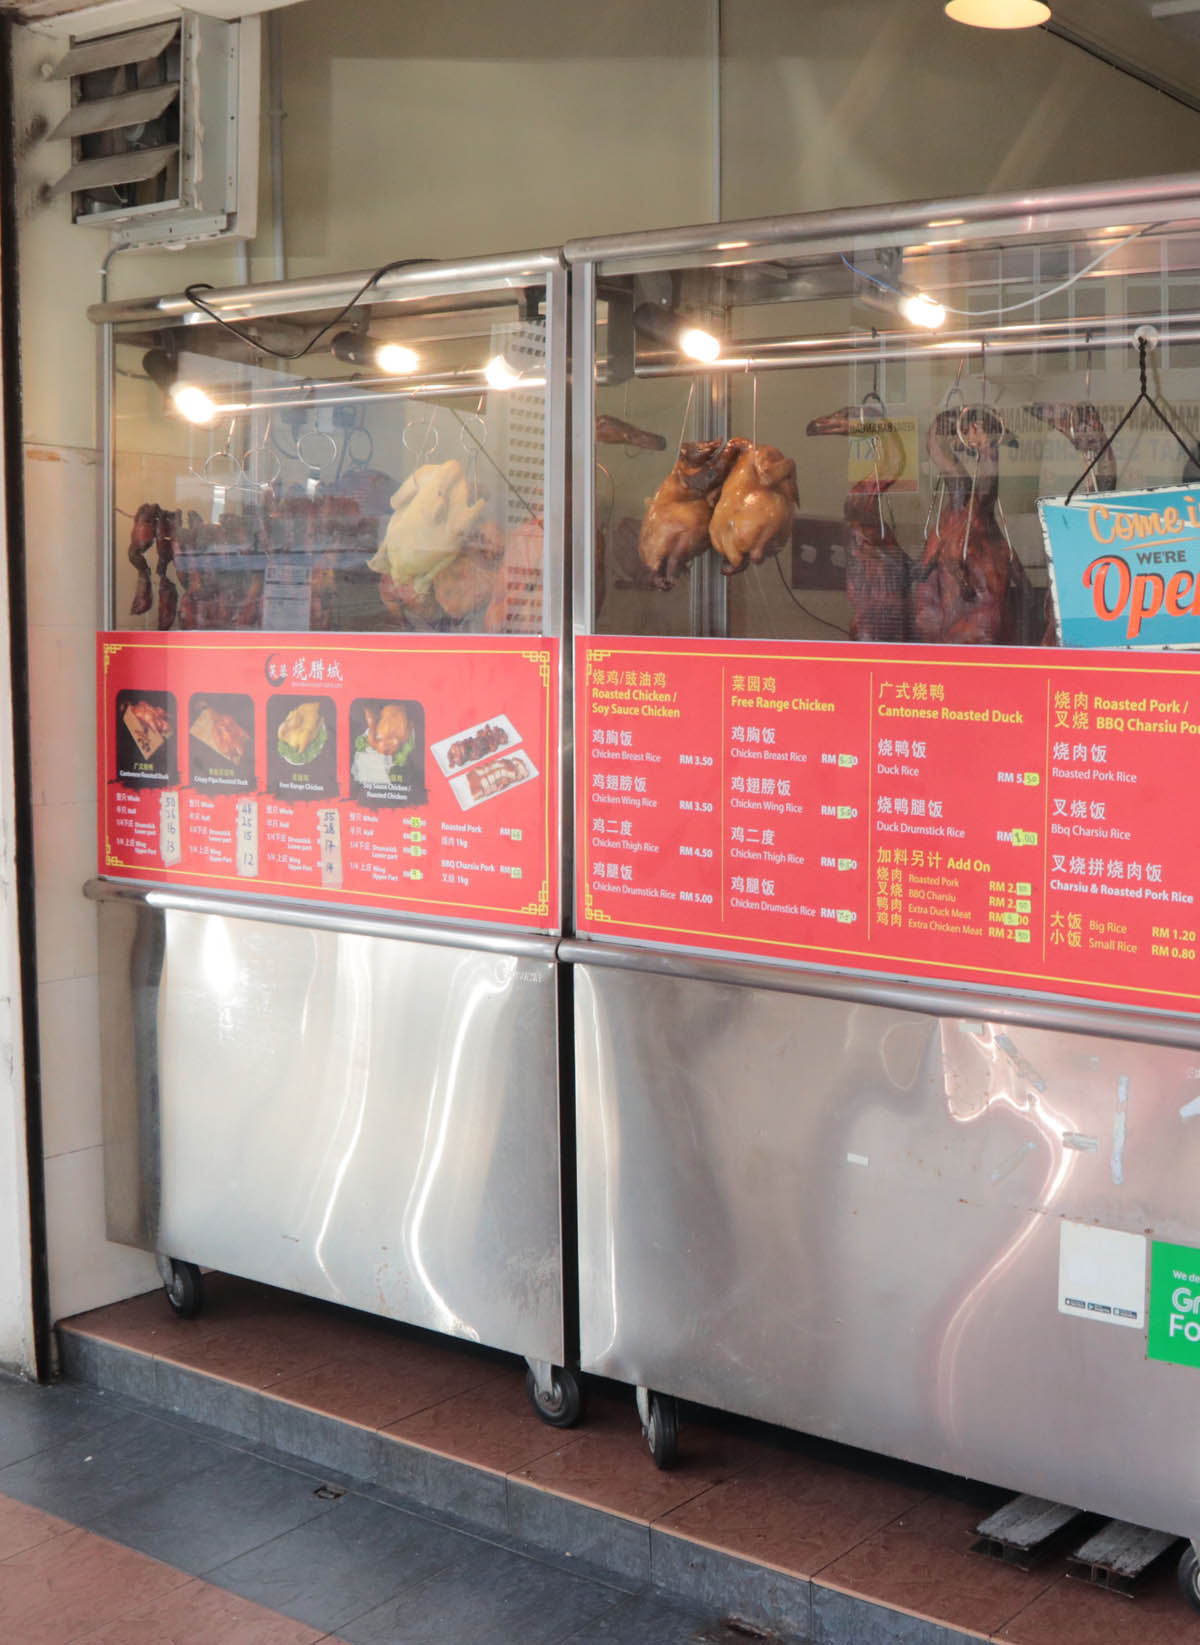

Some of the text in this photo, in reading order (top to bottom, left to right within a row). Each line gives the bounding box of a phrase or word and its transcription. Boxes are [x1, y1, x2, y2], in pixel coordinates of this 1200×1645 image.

[1088, 504, 1184, 545] Come
[1136, 550, 1187, 565] WE'RE
[732, 675, 776, 693] 菜园鸡
[879, 681, 944, 701] 广式烧鸭
[592, 688, 630, 700] Roasted
[632, 690, 671, 701] Chicken
[1055, 691, 1088, 710] 烧肉
[592, 702, 680, 717] Soy Sauce Chicken
[732, 696, 834, 712] Free Range Chicken
[1094, 697, 1146, 712] Roasted
[1150, 700, 1180, 712] Pork
[878, 705, 1023, 723] Cantonese Roasted Duck
[1055, 711, 1088, 729] 叉烧
[1097, 717, 1124, 731] BBQ
[1127, 718, 1177, 733] Charsiu
[593, 729, 632, 746] 鸡胸饭
[732, 726, 775, 744] 鸡胸饭
[592, 749, 661, 762] Chicken Breast Rice
[731, 748, 807, 762] Chicken Breast Rice
[878, 739, 926, 758] 烧鸭饭
[1053, 742, 1106, 763] 烧肉饭
[680, 755, 713, 766] RM 3.50
[822, 754, 836, 764] RM
[878, 764, 919, 776] Duck Rice
[998, 772, 1014, 782] RM
[1052, 767, 1136, 783] Roasted Pork Rice
[731, 776, 790, 796] 鸡翅膀饭
[592, 793, 657, 808] Chicken Wing Rice
[680, 800, 712, 812] RM 3.50
[730, 798, 803, 814] Chicken Wing Rice
[878, 796, 943, 817] 烧鸭腿饭
[821, 805, 836, 816] RM
[1053, 799, 1105, 819] 叉烧饭
[593, 818, 632, 838] 鸡二度
[731, 826, 774, 845] 鸡二度
[877, 821, 965, 838] Duck Drumstick Rice
[997, 830, 1012, 842] RM
[1051, 824, 1131, 840] Bbq Charsiu Rice
[592, 837, 659, 852] Chicken Thigh Rice
[680, 846, 712, 857] RM 4.50
[730, 848, 804, 864] Chicken Thigh Rice
[821, 857, 835, 867] RM
[877, 847, 942, 870] 加料另计
[593, 862, 632, 882] 鸡腿饭
[947, 858, 990, 872] Add On
[1052, 854, 1163, 883] 叉烧拼烧肉饭
[876, 866, 903, 883] 烧肉
[909, 874, 959, 886] Roasted Pork
[593, 881, 676, 899] Chicken Drumstick Rice
[731, 876, 775, 896] 鸡腿饭
[876, 881, 903, 898] 叉烧
[909, 889, 927, 899] BBQ
[989, 881, 1005, 891] RM
[1050, 880, 1193, 903] Charsiu & Roasted Pork Rice
[680, 891, 713, 903] RM 5.00
[876, 896, 902, 913] 鸭肉
[989, 896, 1005, 907] RM
[730, 898, 816, 916] Chicken Drumstick Rice
[821, 908, 836, 918] RM
[909, 904, 971, 919] Extra Duck Meat
[876, 912, 902, 928] 鸡肉
[908, 919, 982, 936] Extra Chicken Meat
[1050, 910, 1083, 930] 大饭
[1090, 920, 1127, 934] Big Rice
[989, 927, 1004, 938] RM
[1050, 928, 1083, 949] 小饭
[1152, 927, 1196, 941] RM 1.20
[1089, 938, 1137, 952] Small Rice
[1152, 945, 1195, 960] RM 0.80
[1173, 1270, 1187, 1281] We
